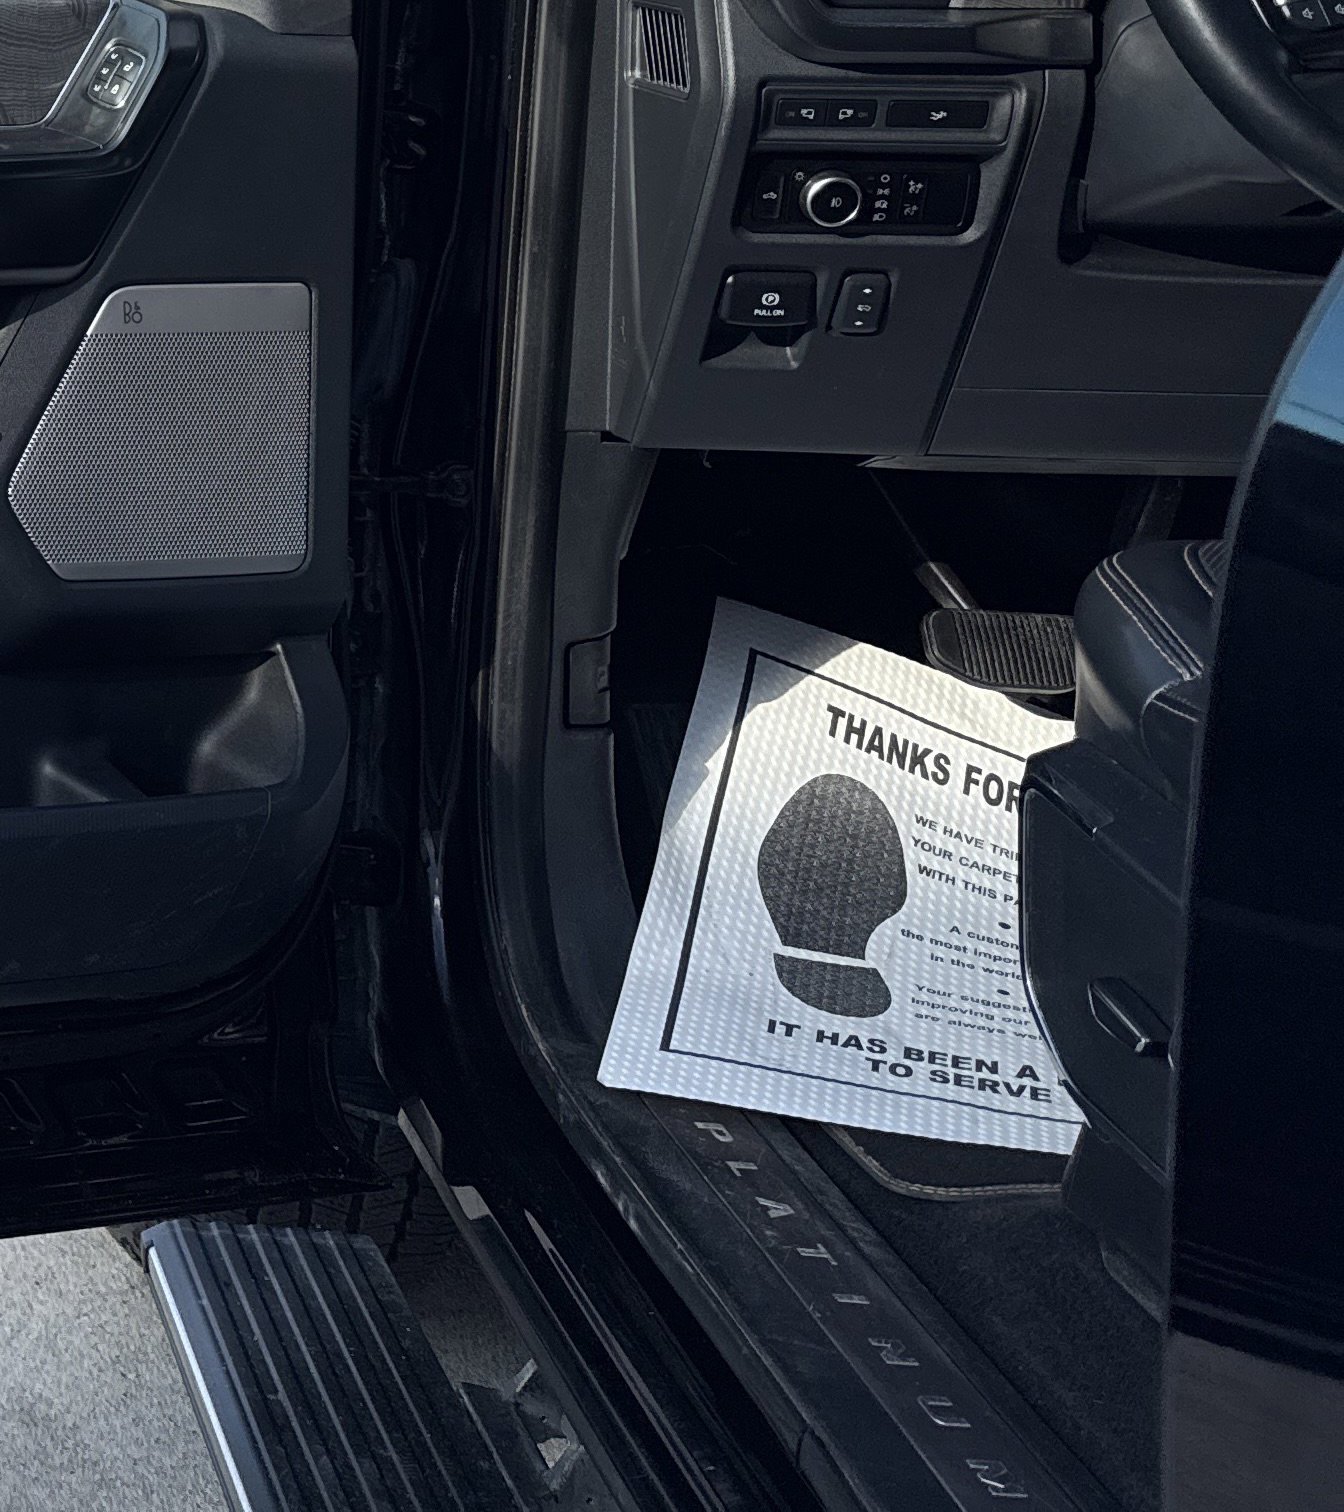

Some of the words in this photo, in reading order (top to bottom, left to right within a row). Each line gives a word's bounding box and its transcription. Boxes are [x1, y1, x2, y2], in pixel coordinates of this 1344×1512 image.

[826, 703, 951, 786] THANKS
[914, 814, 938, 832] WE
[943, 826, 985, 849] HAVE
[911, 835, 953, 861] YOUR
[917, 864, 956, 886] WITH
[962, 879, 997, 899] THIS
[900, 928, 924, 942] the
[929, 937, 968, 954] most
[949, 925, 962, 935] A
[930, 952, 944, 963] in
[950, 958, 975, 970] the
[914, 983, 953, 998] Your
[911, 996, 995, 1021] improving
[1001, 1016, 1031, 1026] our
[914, 1012, 941, 1022] are
[947, 1019, 1006, 1034] always
[767, 1019, 801, 1037] IT
[815, 1029, 888, 1054] HAS
[903, 1046, 999, 1075] BEEN
[1015, 1064, 1041, 1082] A
[865, 1057, 913, 1078] TO
[929, 1069, 1052, 1103] SERVE
[693, 1119, 1029, 1499] PLATINUM
